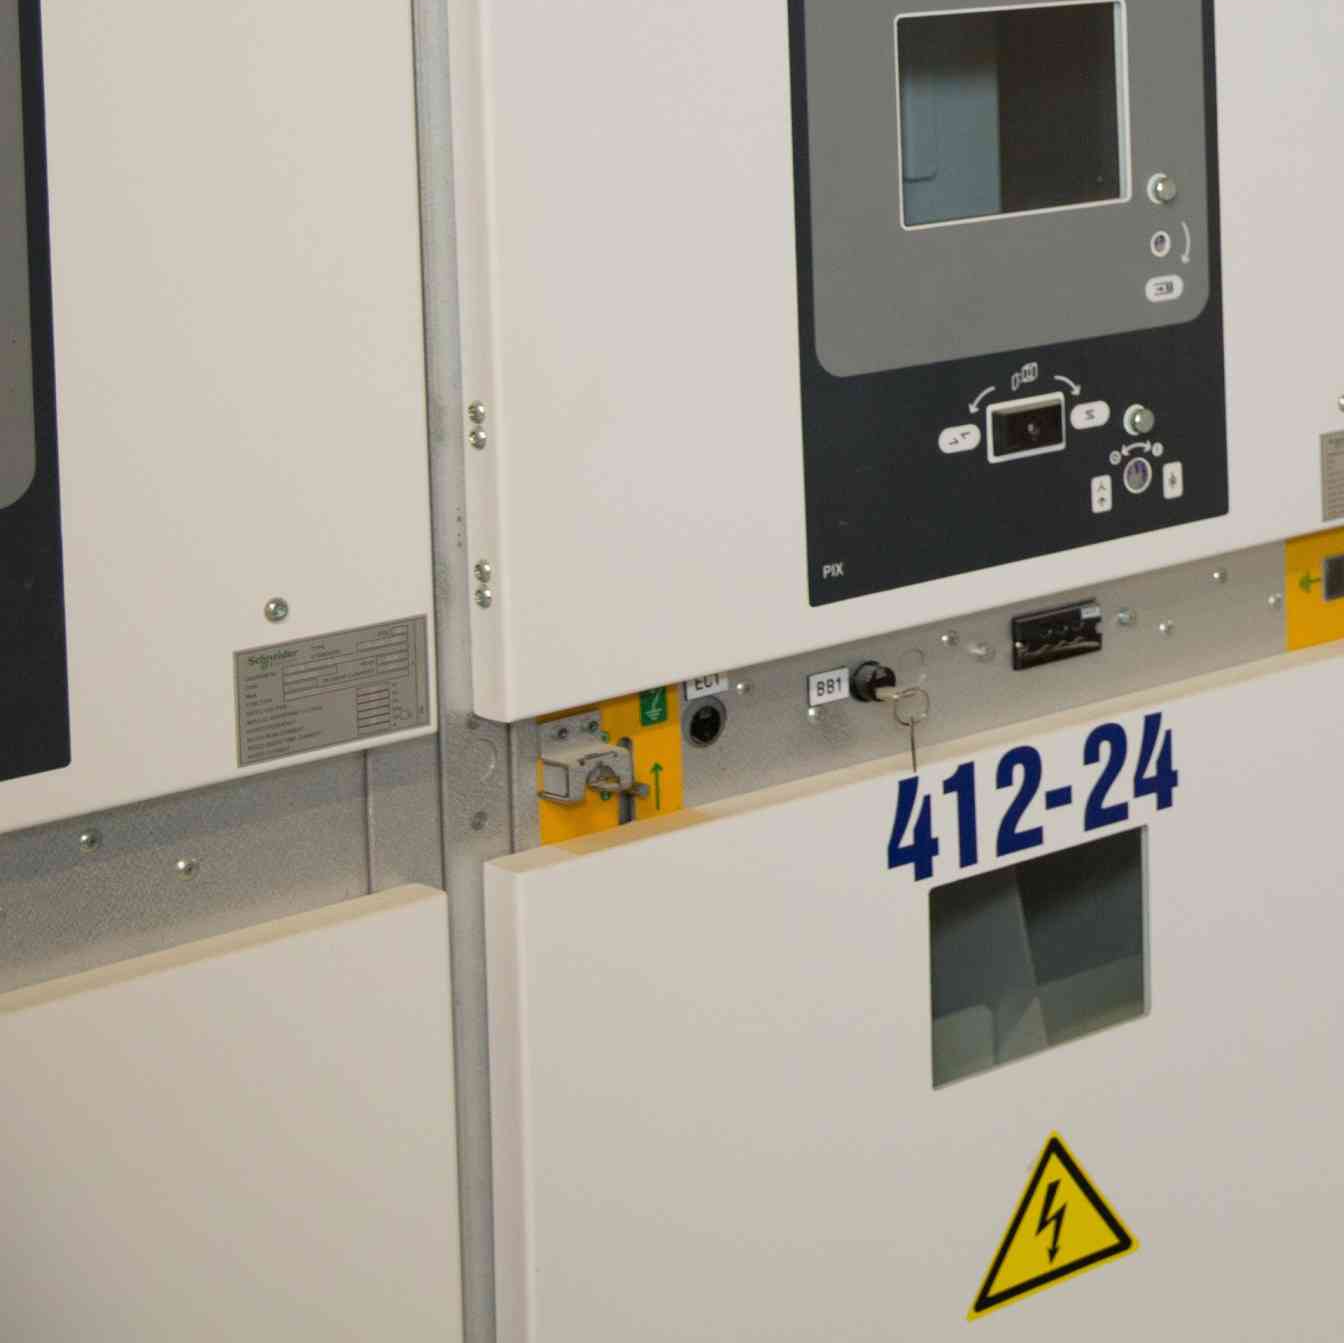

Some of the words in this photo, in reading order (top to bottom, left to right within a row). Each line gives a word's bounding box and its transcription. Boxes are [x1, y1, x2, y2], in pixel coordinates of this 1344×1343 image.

[821, 562, 845, 581] PIX
[816, 677, 843, 697] BB1
[887, 711, 1180, 883] 412-24
